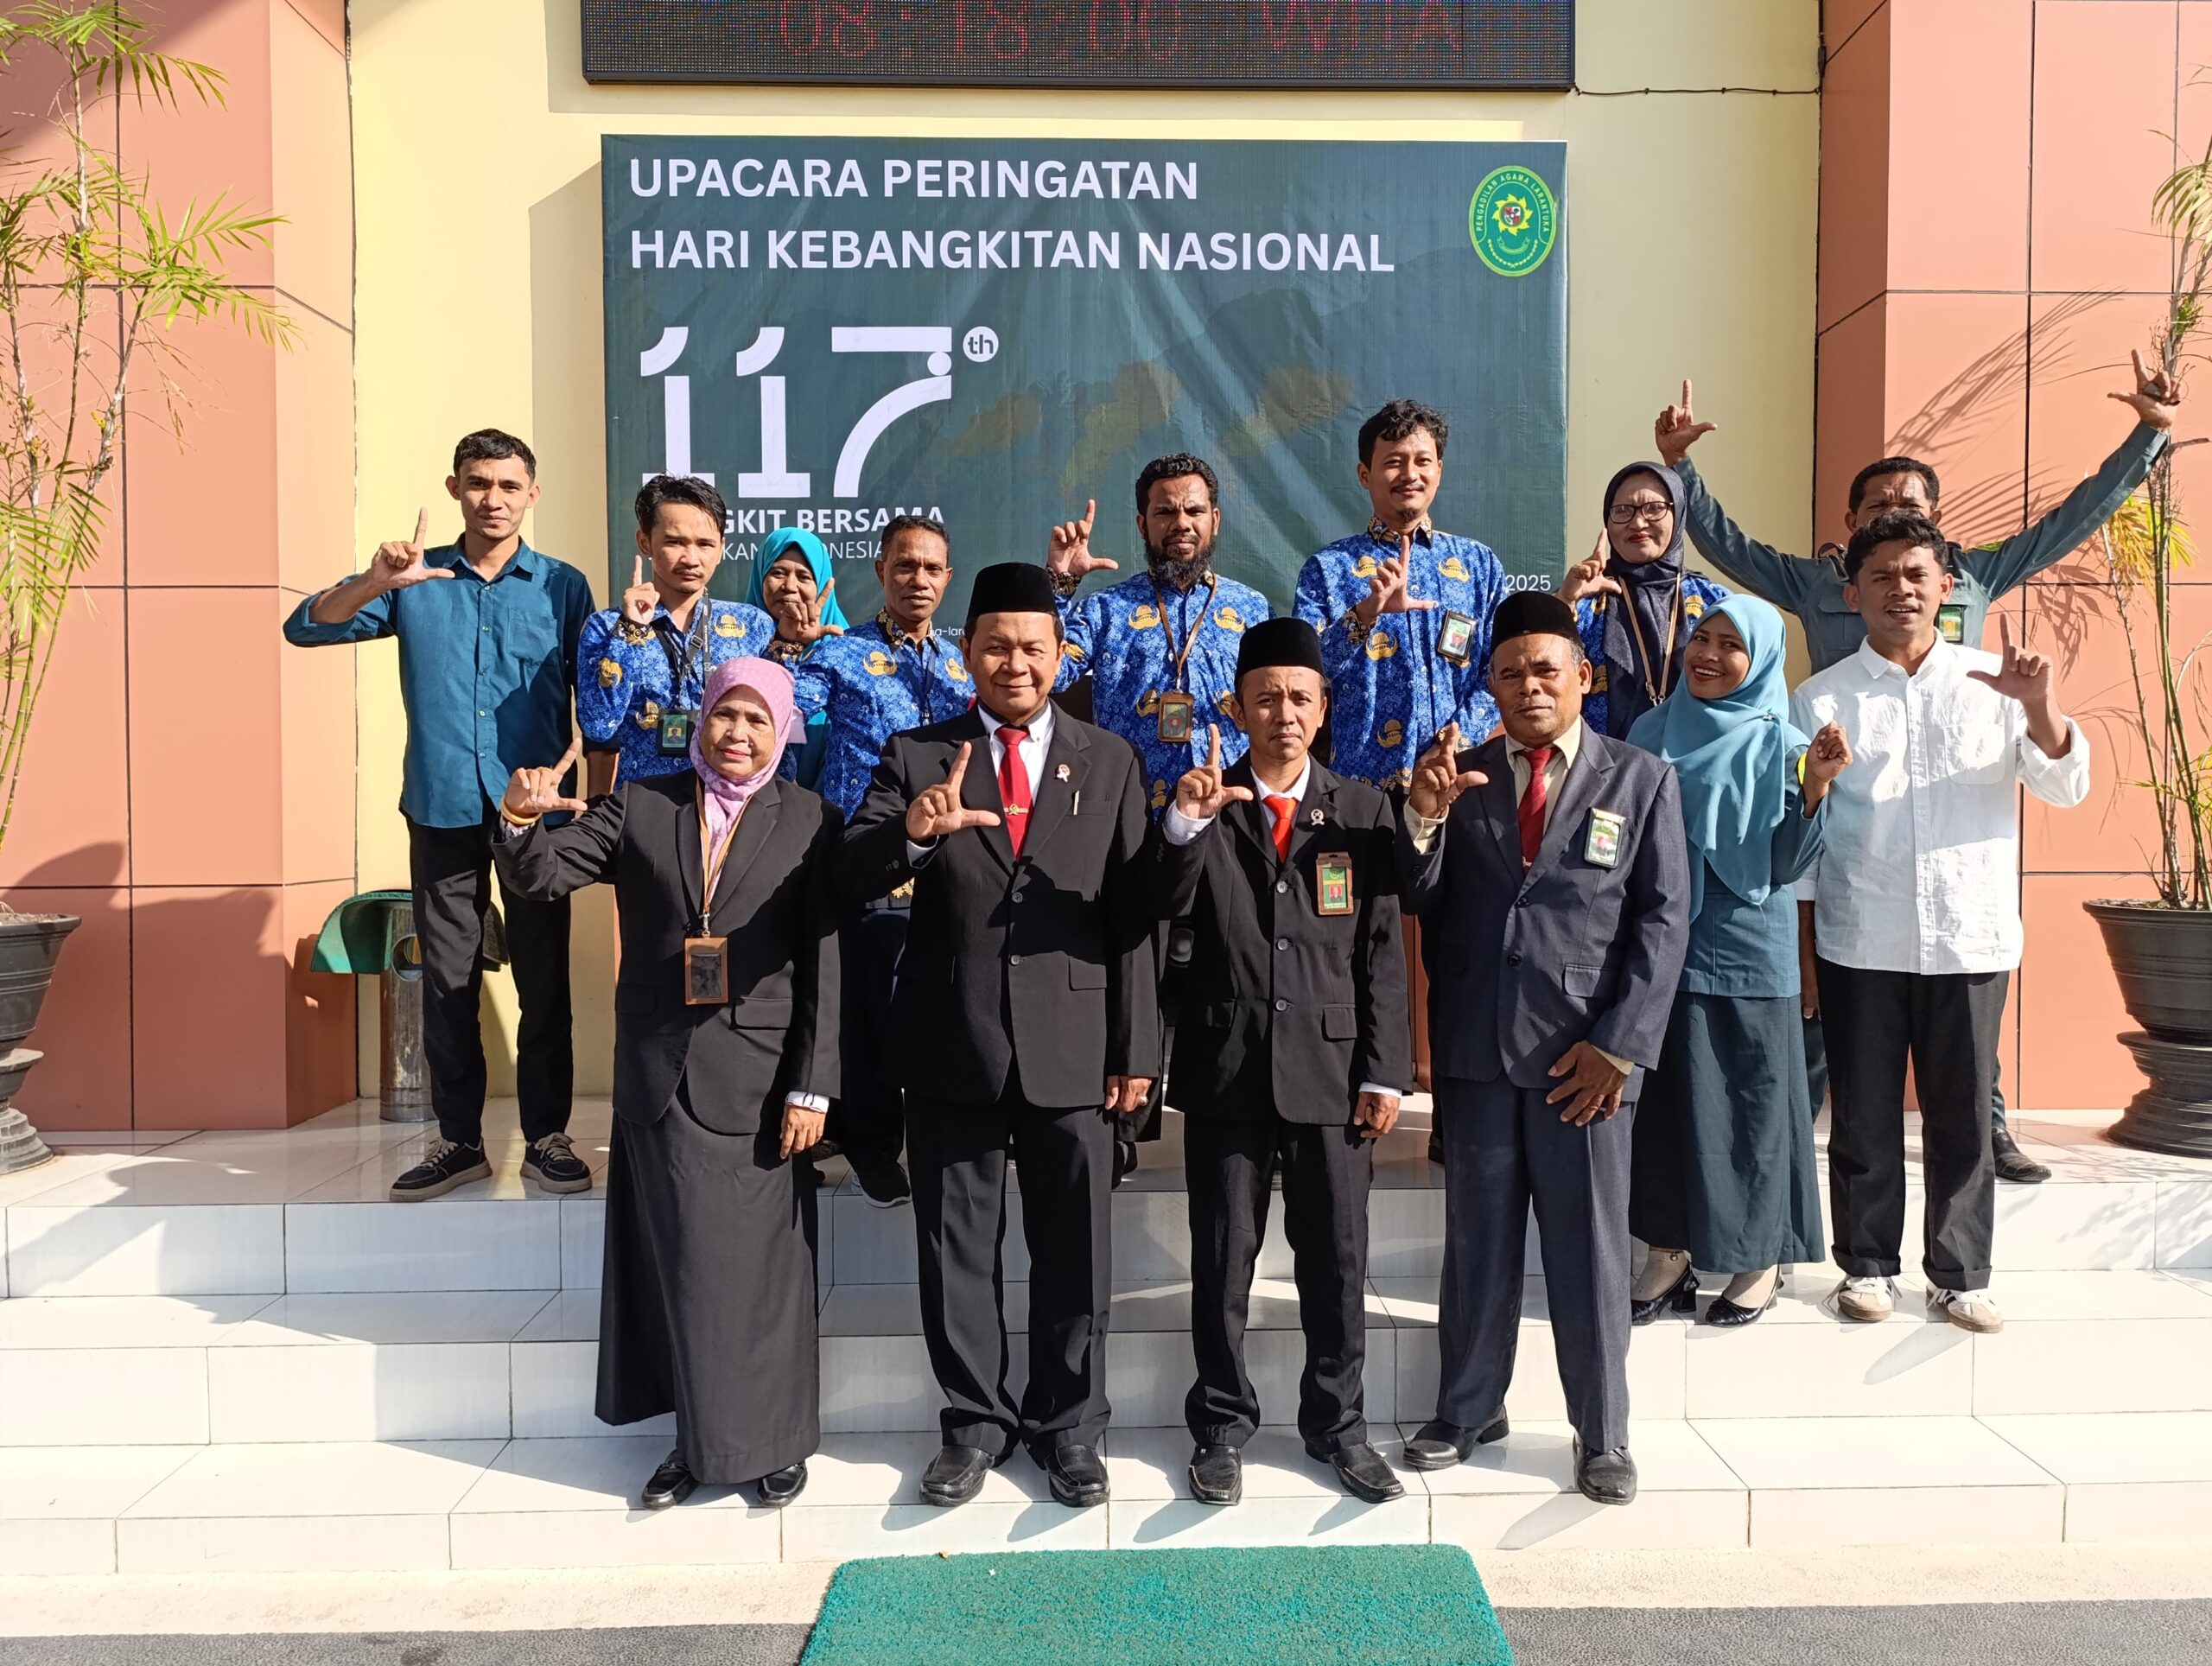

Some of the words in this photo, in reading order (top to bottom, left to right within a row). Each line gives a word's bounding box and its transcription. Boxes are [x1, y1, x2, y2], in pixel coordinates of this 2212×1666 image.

[630, 158, 869, 198] UPACARA
[884, 159, 1197, 200] PERINGATAN
[1476, 179, 1498, 232] PENGADILAN
[1500, 173, 1529, 184] AGAMA
[1530, 182, 1550, 232] LARANTUKA
[632, 230, 749, 269] HARI
[768, 230, 1120, 270] KEBANGKITAN
[1138, 232, 1395, 272] NASIONAL
[640, 326, 952, 499] 117
[967, 336, 995, 354] th
[1505, 574, 1551, 591] 2025
